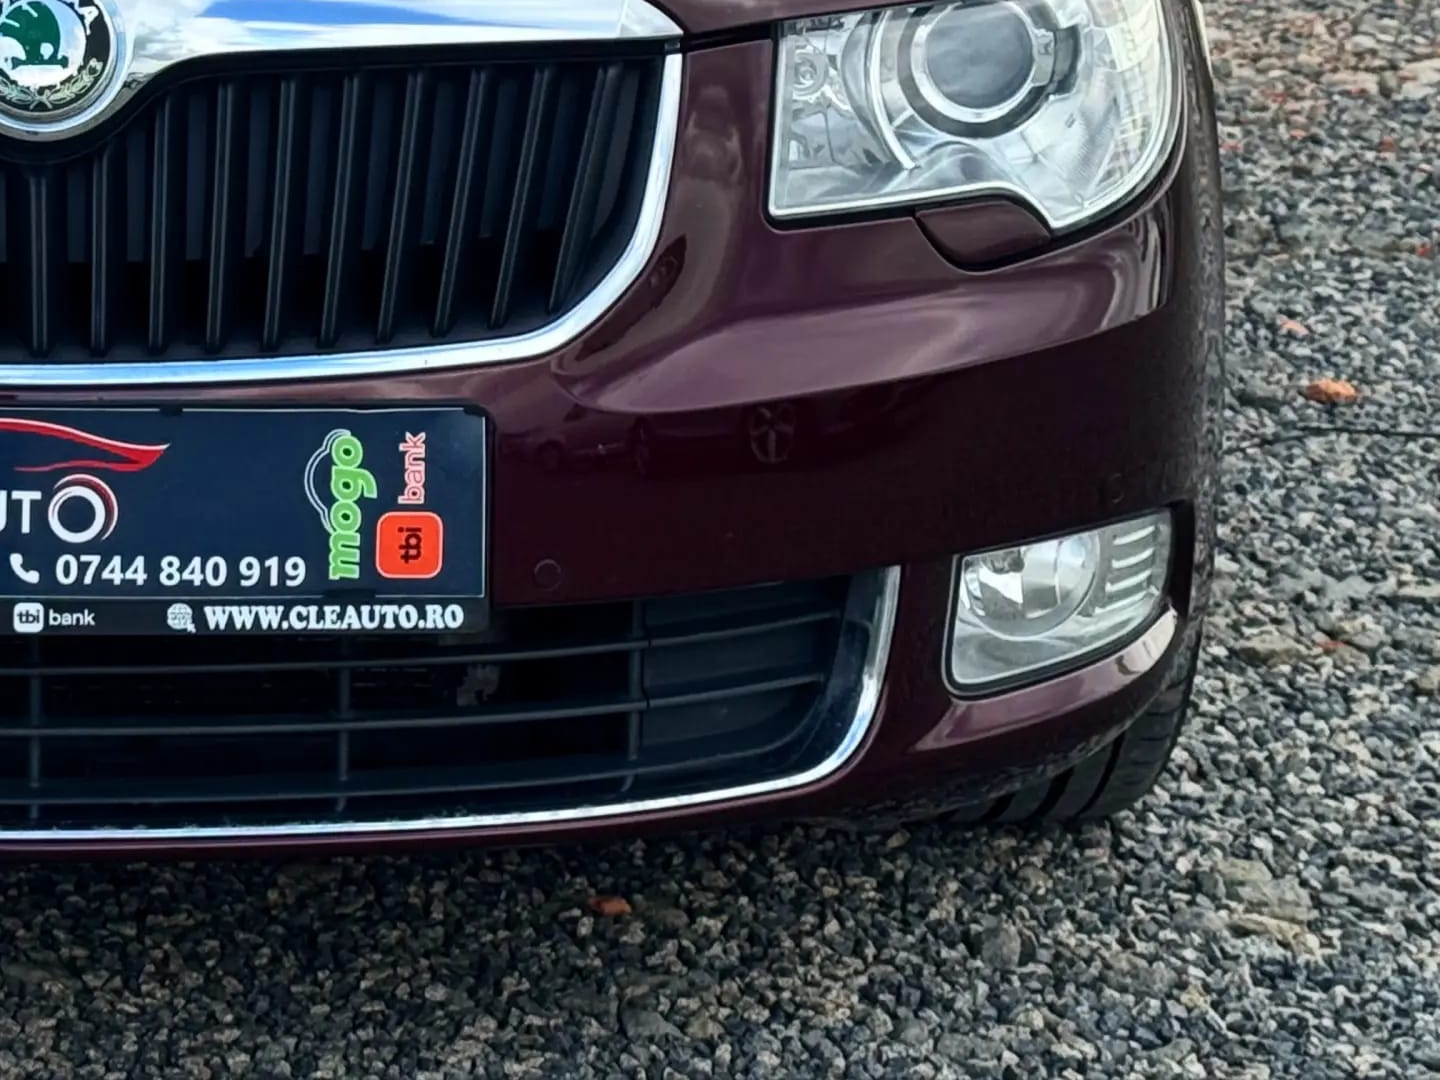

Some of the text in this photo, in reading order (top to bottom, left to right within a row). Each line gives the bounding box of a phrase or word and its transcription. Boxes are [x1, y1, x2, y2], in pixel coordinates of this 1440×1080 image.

[328, 435, 378, 580] mogo
[397, 432, 427, 564] tbi bank
[56, 554, 306, 587] 0744 840 919
[48, 608, 96, 626] bank
[203, 603, 465, 630] WWW.CLEAUTO.RO
